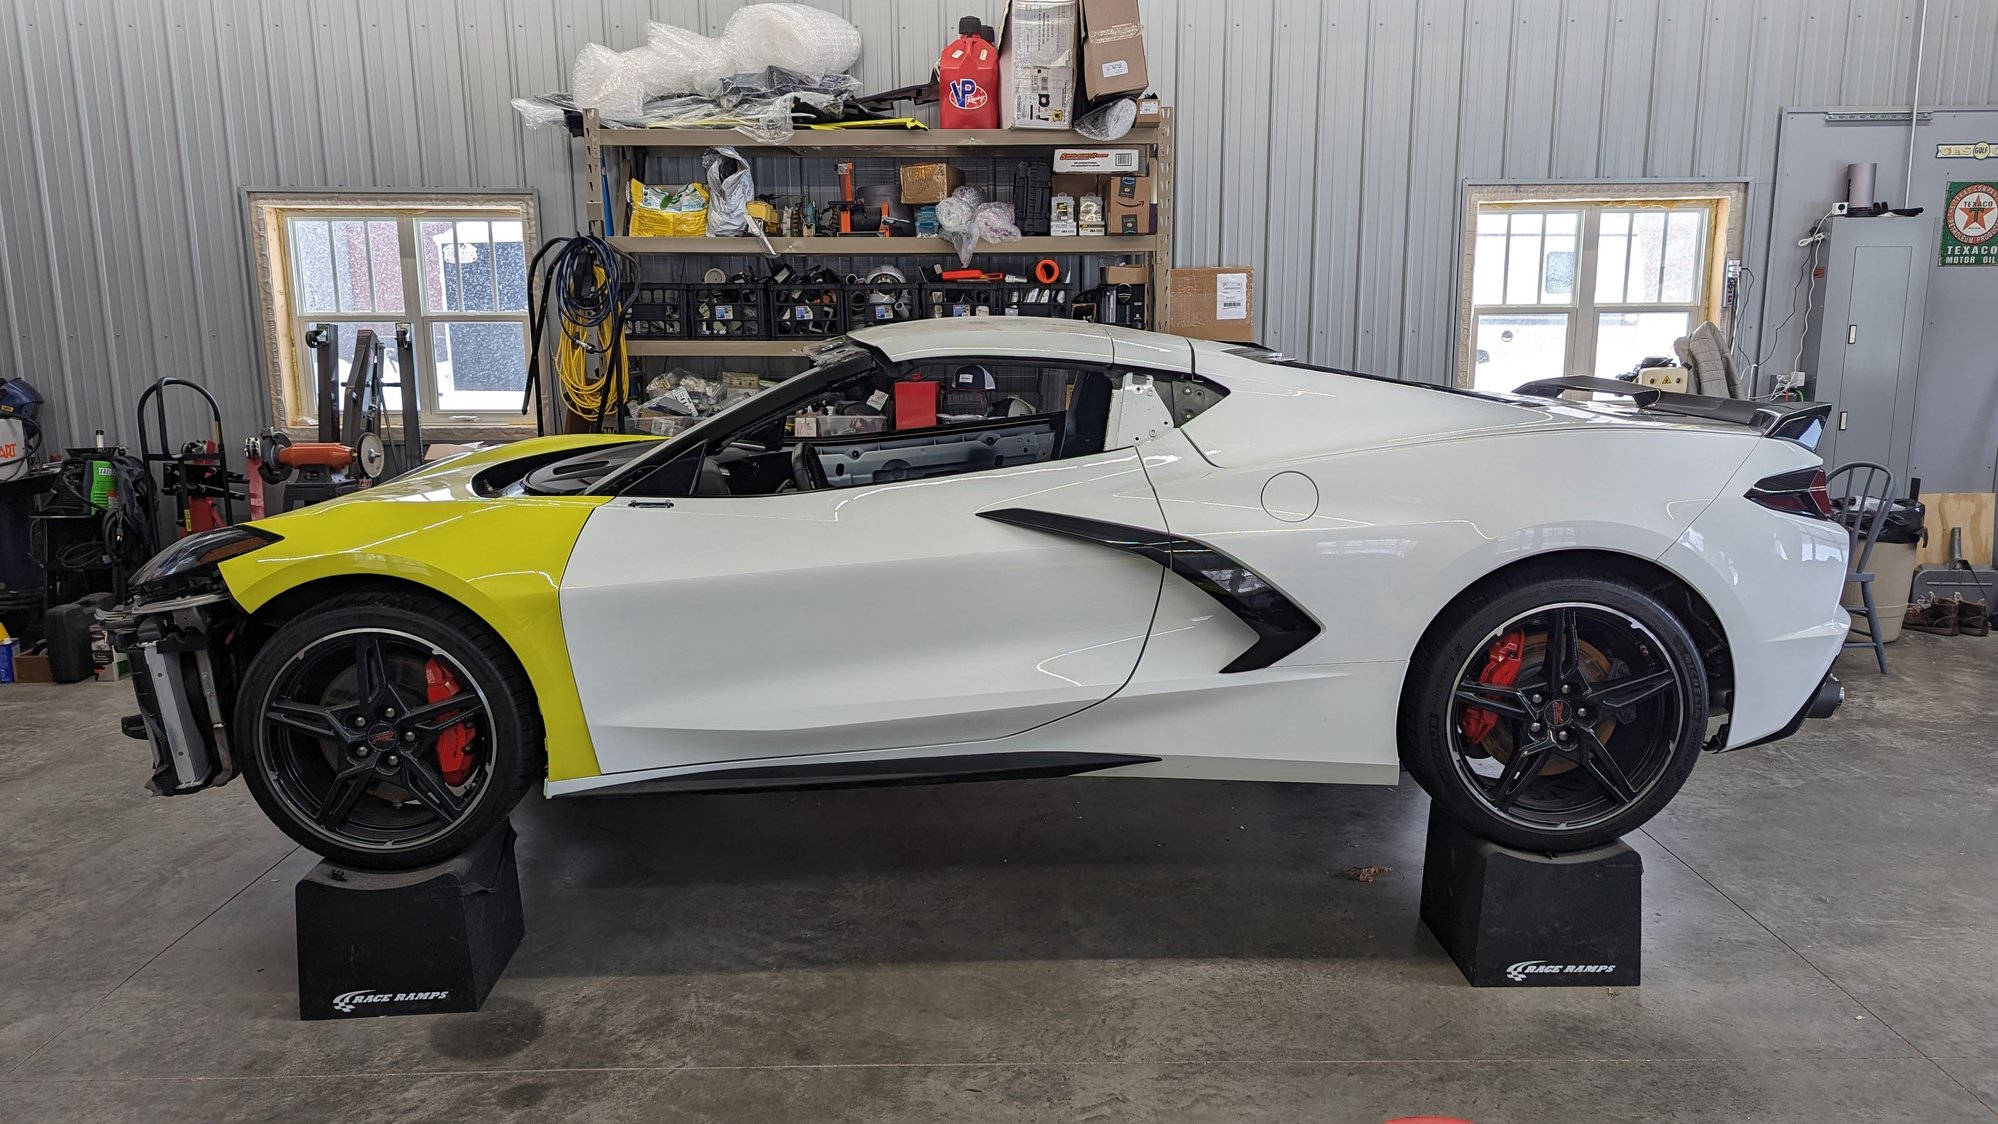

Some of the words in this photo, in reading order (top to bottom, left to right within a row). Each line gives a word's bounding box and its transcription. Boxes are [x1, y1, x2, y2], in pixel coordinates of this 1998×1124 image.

[950, 79, 977, 109] VP
[1974, 146, 1988, 154] GULF
[1947, 245, 1998, 255] TEXACO
[1945, 256, 1976, 264] MOTOR
[1983, 256, 1996, 264] OIL
[1683, 653, 1702, 722] MICHELIN
[1524, 965, 1563, 973] RACE
[352, 993, 393, 1004] RACE
[393, 991, 449, 1002] RAMPS
